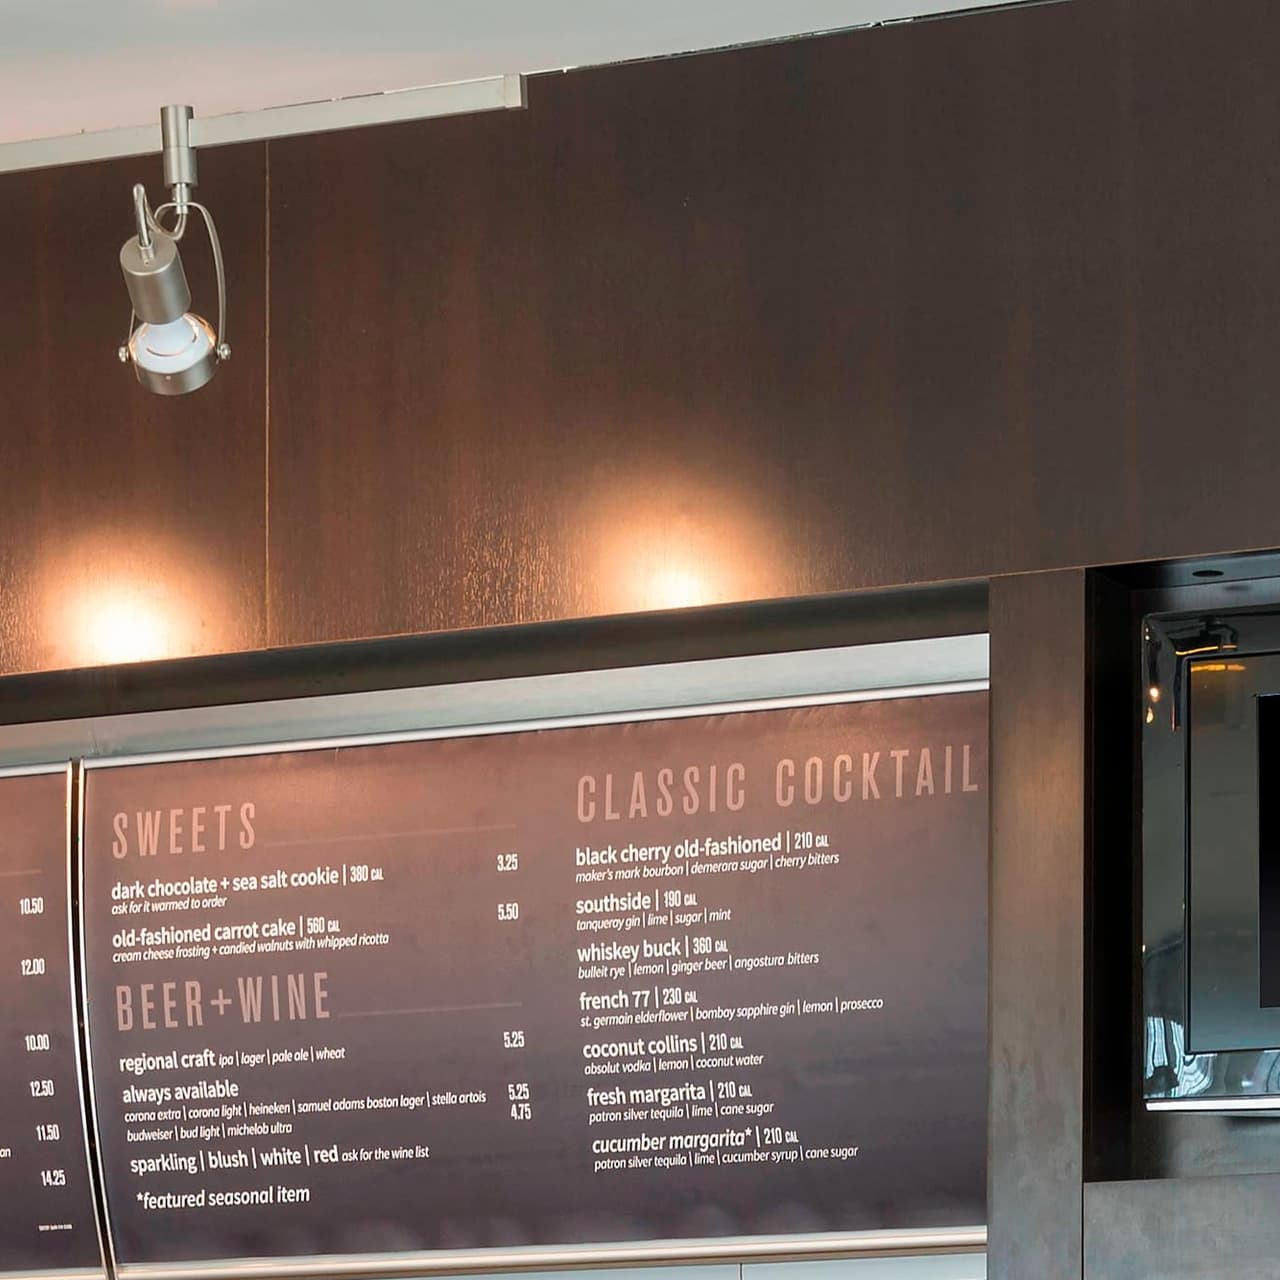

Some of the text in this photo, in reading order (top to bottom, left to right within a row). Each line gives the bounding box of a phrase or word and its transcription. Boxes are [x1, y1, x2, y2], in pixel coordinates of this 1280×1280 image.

[578, 742, 977, 822] CLASSIC COCKTAIL
[113, 802, 255, 858] SWEETS
[576, 832, 812, 866] black cherry old-fashioned 210
[498, 854, 518, 871] 3.25
[112, 866, 338, 900] dark chocolate sea salt cookie
[498, 903, 518, 920] 5.50
[576, 892, 650, 914] southside
[113, 918, 295, 948] old-fashioned carrot cake
[577, 919, 624, 932] tanqueray
[648, 914, 668, 925] lime
[675, 913, 702, 926] sugar
[709, 909, 731, 921] mint
[577, 938, 681, 963] whiskey buck
[580, 988, 682, 1010] french 77 230
[504, 1031, 524, 1048] 5.25
[583, 1033, 727, 1058] coconut collins 210
[120, 1051, 178, 1075] regional
[181, 1049, 216, 1068] craft
[241, 1052, 265, 1066] lager
[272, 1050, 292, 1065] pale
[294, 1048, 308, 1061] ale
[316, 1047, 345, 1060] wheat
[123, 1080, 238, 1105] always available
[587, 1083, 705, 1109] fresh margarita
[593, 1133, 666, 1153] cucumber
[131, 1145, 338, 1176] sparkling blush white red
[41, 1170, 65, 1186] 14.25
